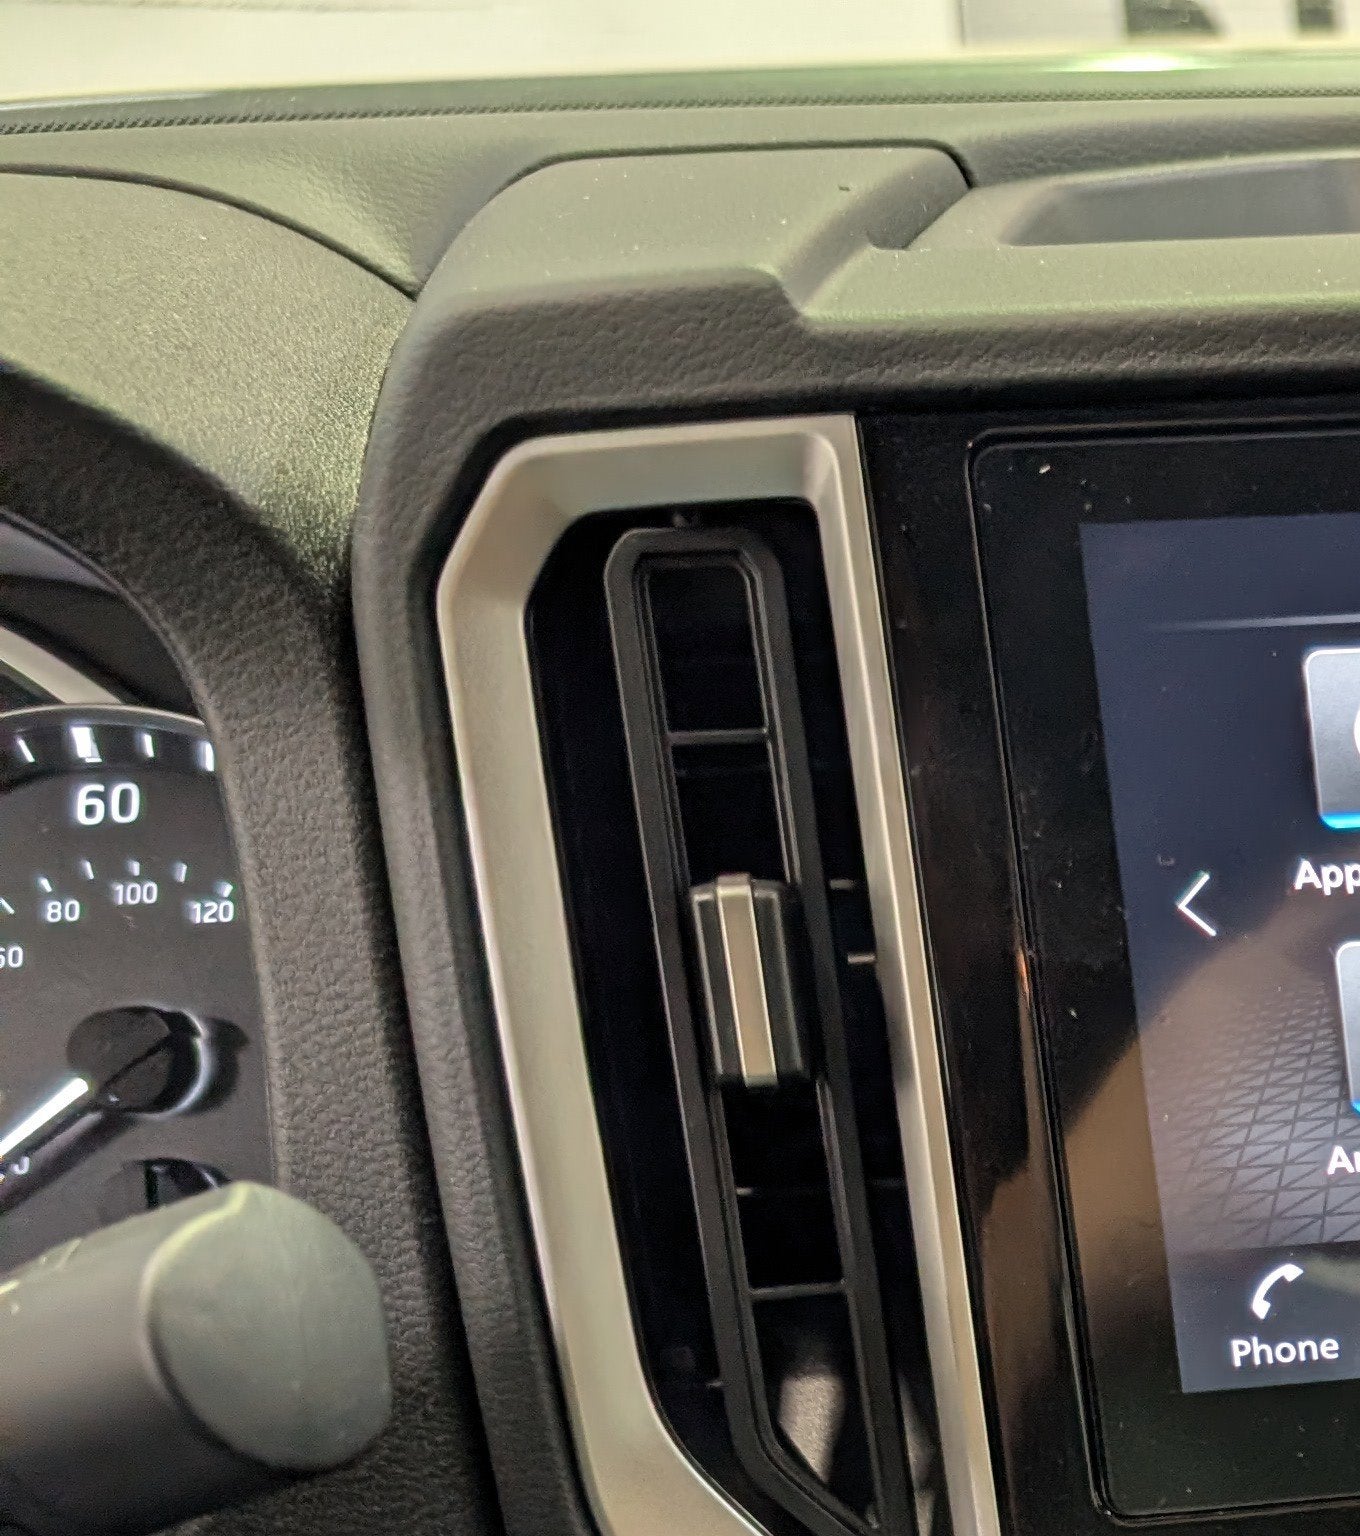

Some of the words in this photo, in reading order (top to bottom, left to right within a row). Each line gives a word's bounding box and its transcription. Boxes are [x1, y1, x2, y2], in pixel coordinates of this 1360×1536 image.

[76, 781, 141, 825] 60
[113, 881, 158, 906] 100
[46, 899, 80, 923] 80
[191, 900, 235, 924] 120
[1230, 1335, 1341, 1369] Phone
